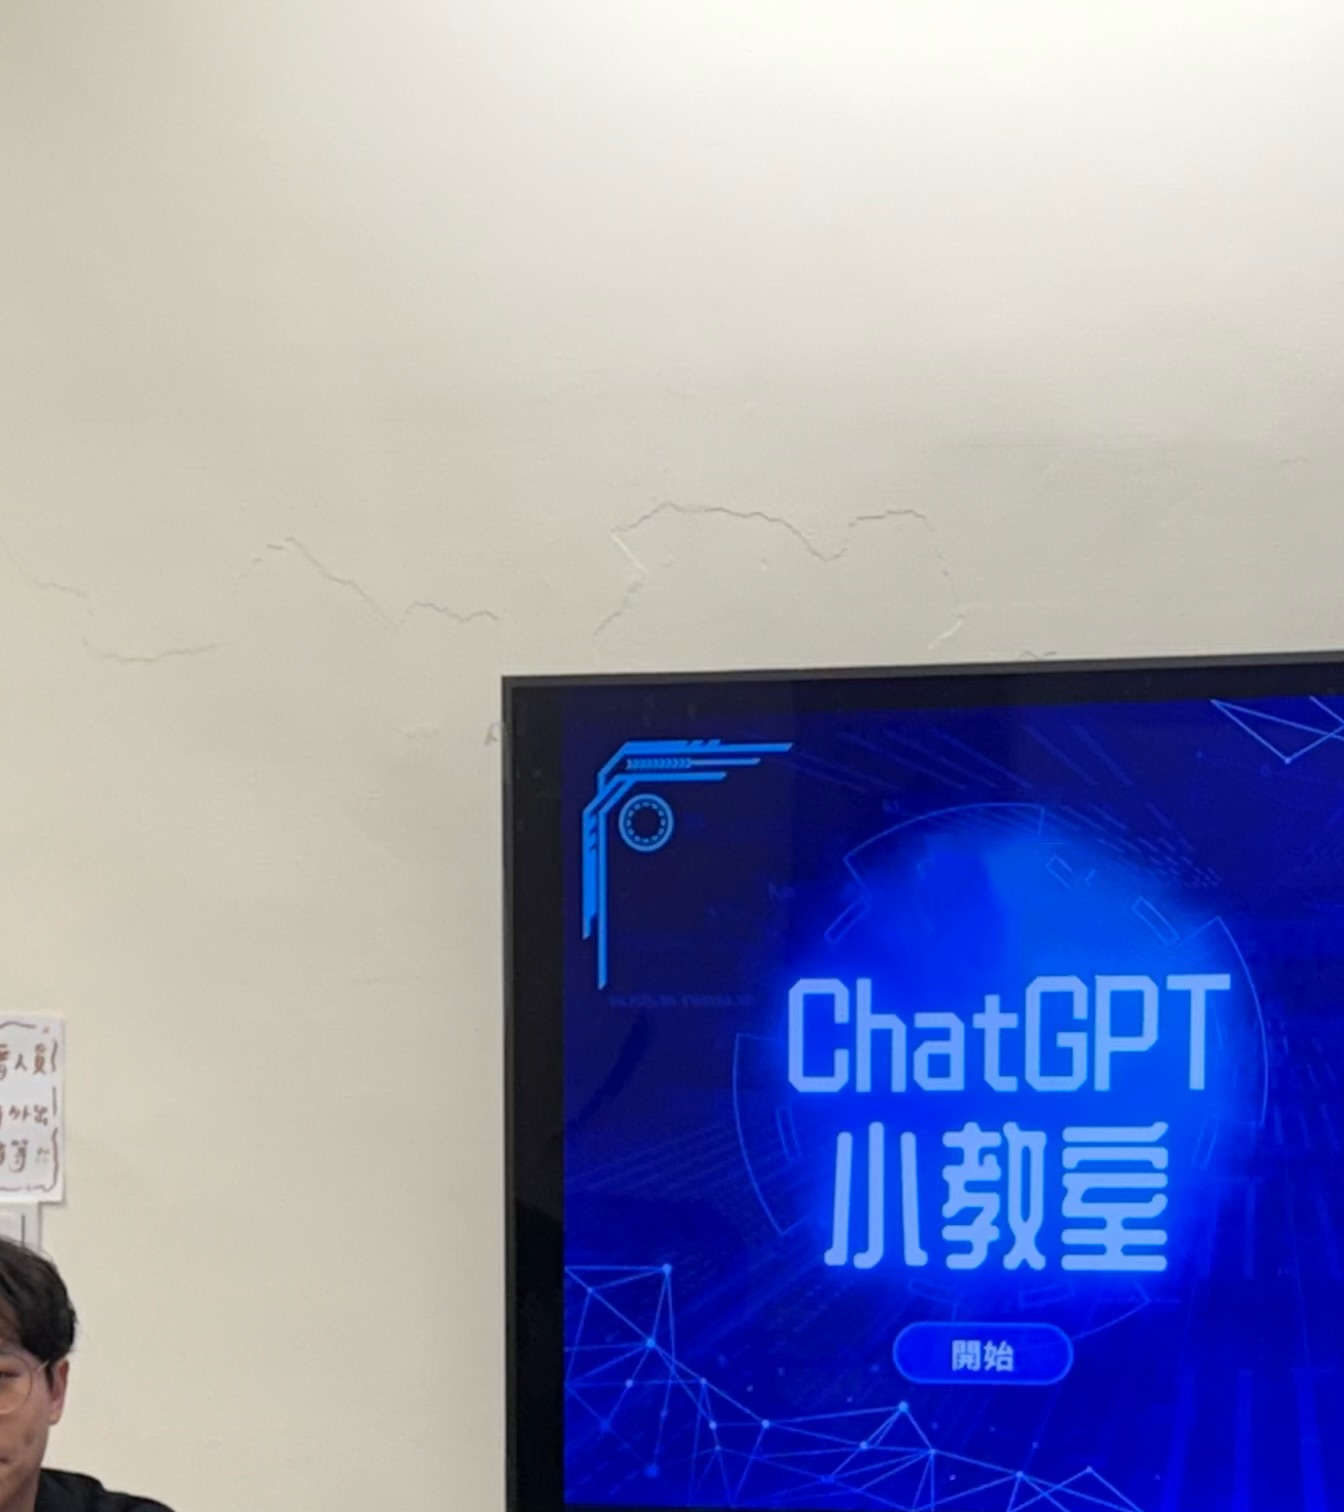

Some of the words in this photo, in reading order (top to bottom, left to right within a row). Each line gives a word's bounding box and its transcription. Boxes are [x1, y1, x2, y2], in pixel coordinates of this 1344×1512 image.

[788, 974, 1231, 1093] ChatGPT
[824, 1121, 1169, 1272] 小教室
[952, 1339, 1014, 1372] 開始
